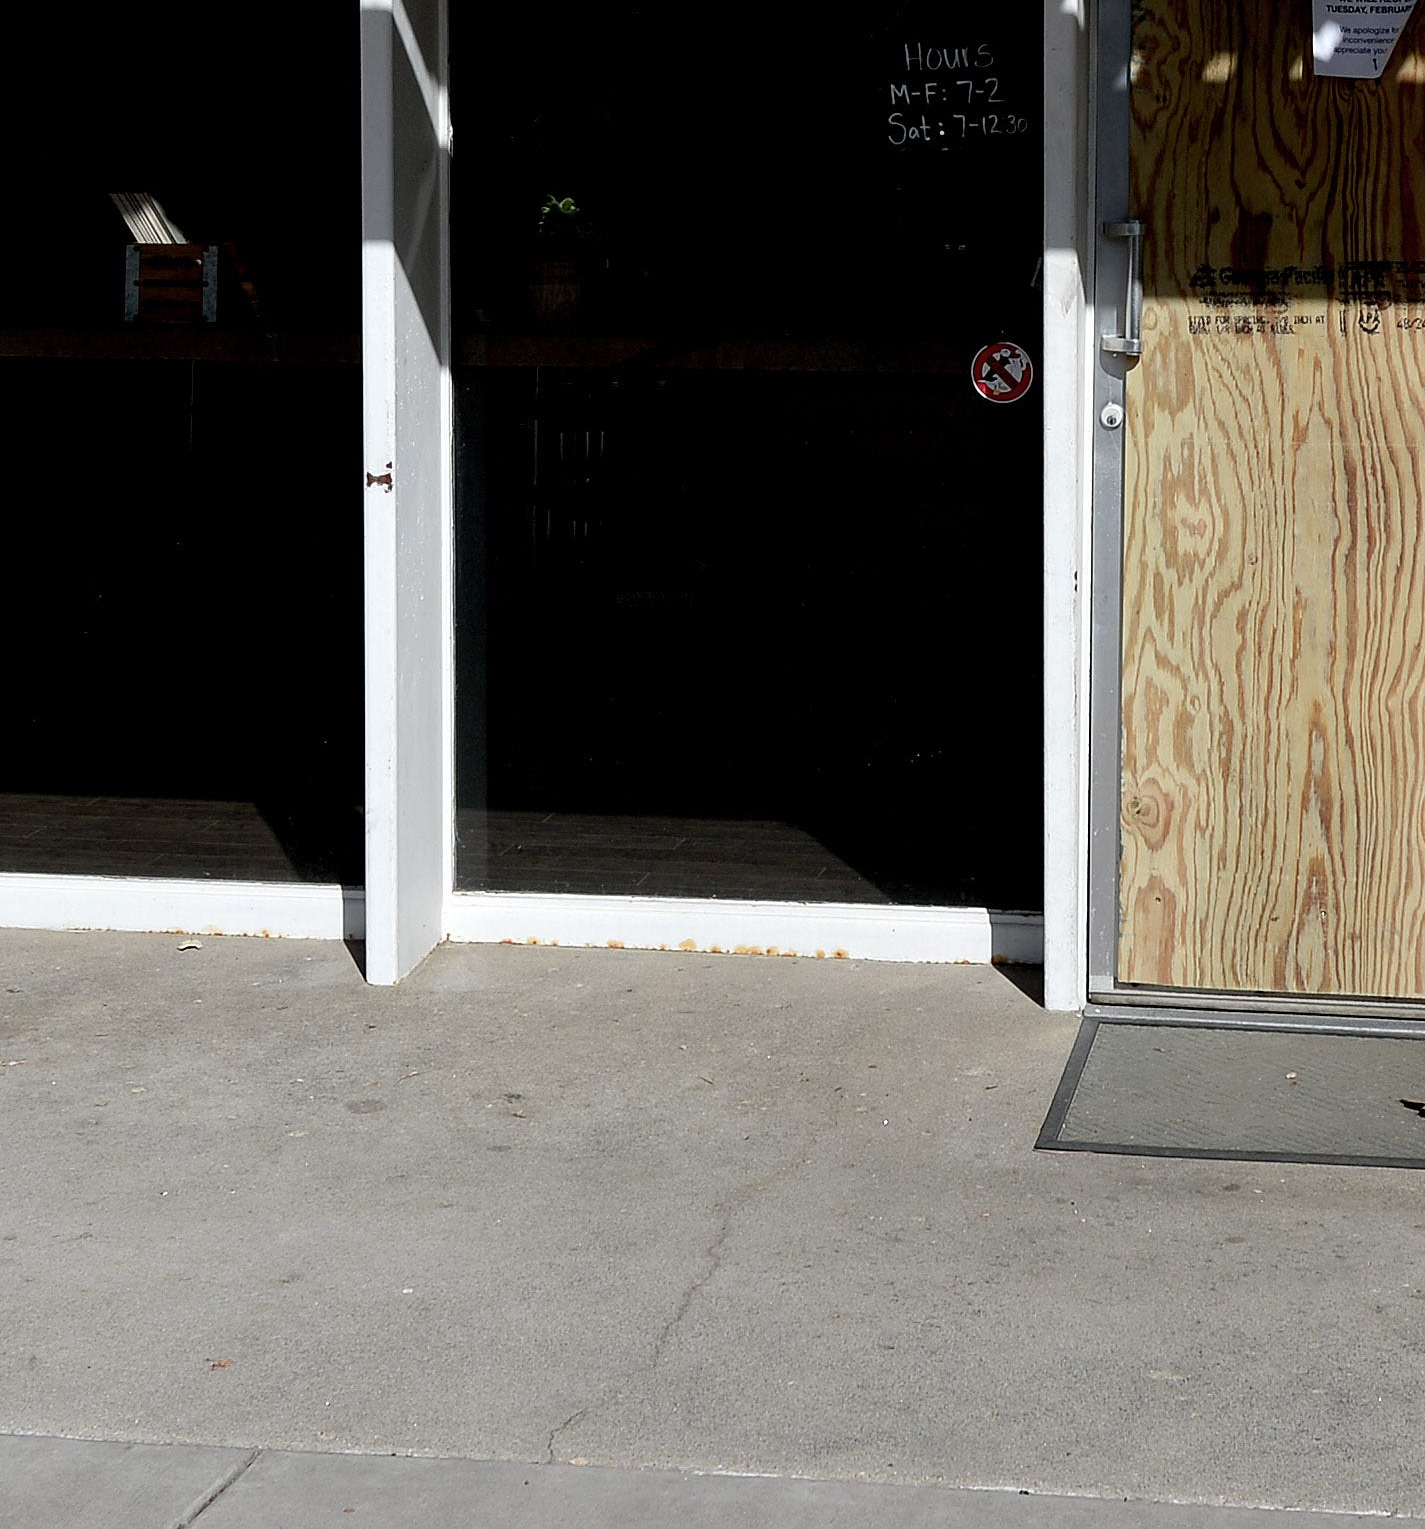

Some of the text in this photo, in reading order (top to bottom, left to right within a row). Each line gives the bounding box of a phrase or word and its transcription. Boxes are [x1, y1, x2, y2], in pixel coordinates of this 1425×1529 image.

[1326, 5, 1367, 15] TUESDAY,
[1353, 27, 1390, 35] apologize
[905, 42, 994, 71] Hours
[956, 77, 1005, 103] 7-2
